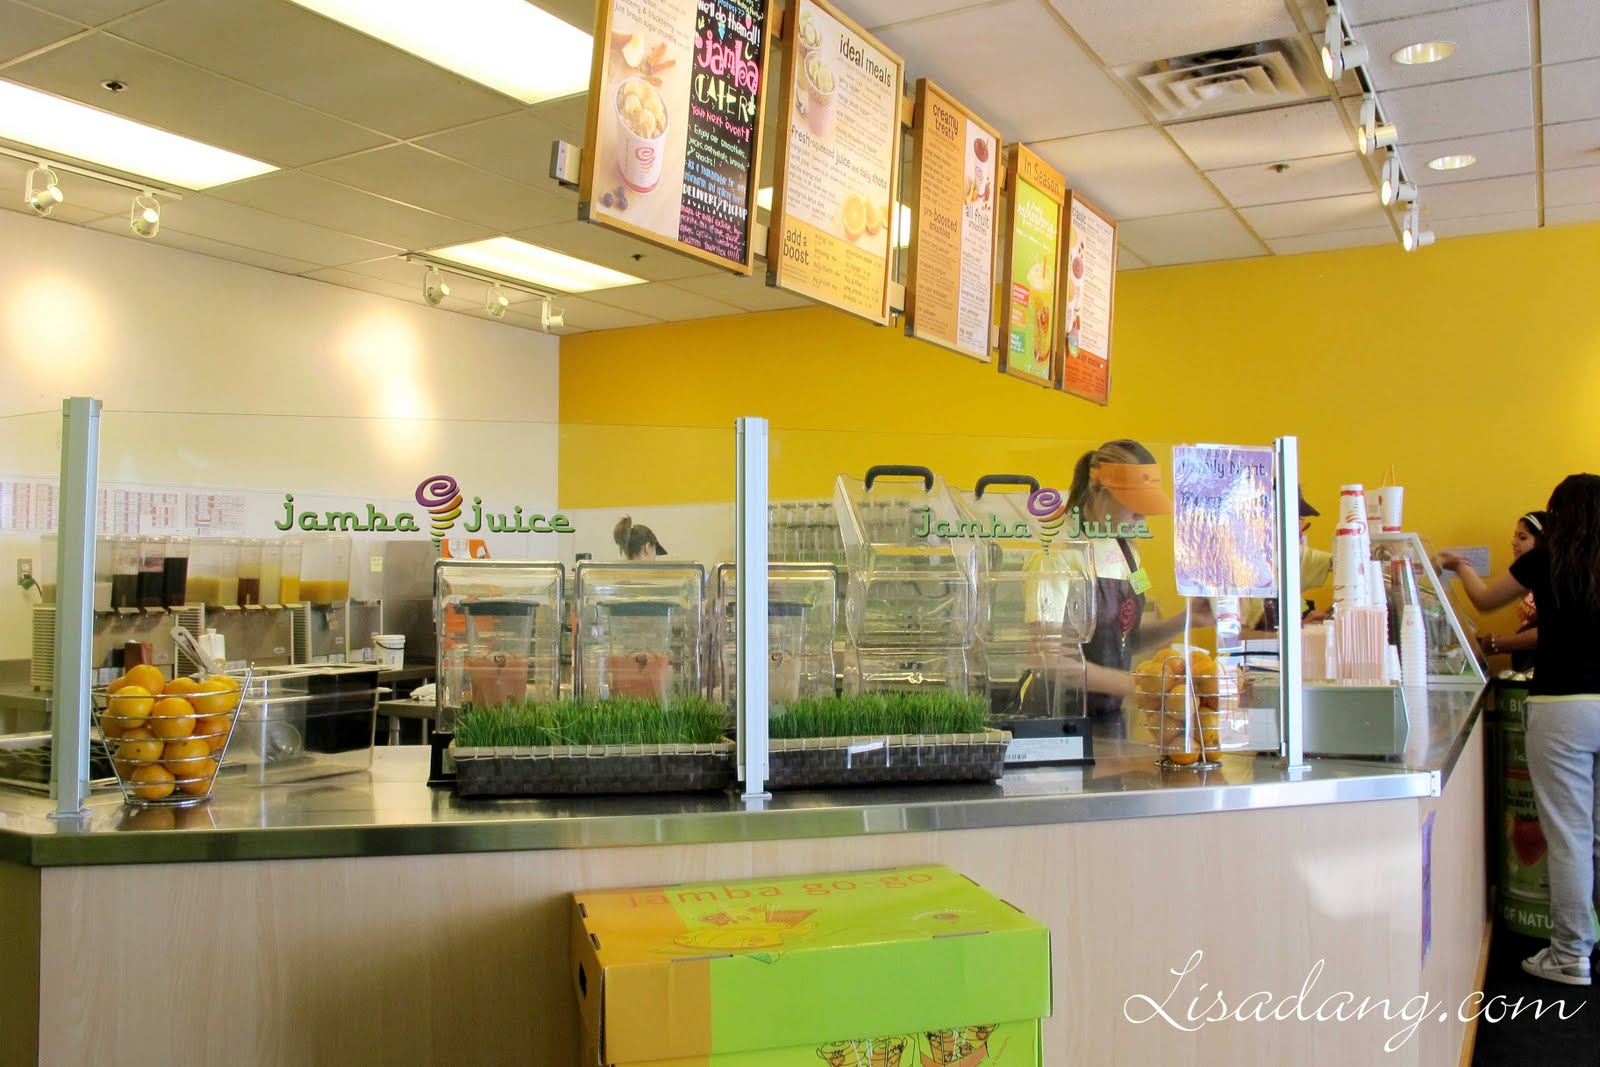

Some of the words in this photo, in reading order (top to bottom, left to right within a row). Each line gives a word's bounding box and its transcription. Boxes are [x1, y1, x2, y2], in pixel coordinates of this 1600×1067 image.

[715, 7, 727, 23] do
[728, 13, 747, 37] them
[698, 30, 759, 95] jamba
[840, 35, 864, 67] ideal
[866, 58, 891, 87] meals
[933, 104, 958, 135] creamy
[935, 119, 955, 140] treats
[790, 124, 834, 159] fresh-squeezed
[835, 151, 851, 168] juice
[1024, 155, 1032, 177] In
[1034, 162, 1059, 196] Season
[682, 183, 718, 207] DELIVERY
[783, 239, 809, 265] boost
[786, 229, 801, 246] add
[803, 235, 807, 246] a
[1229, 460, 1265, 480] Night
[274, 493, 420, 532] jamba
[463, 496, 576, 533] juice
[914, 503, 1032, 538] jamba
[1068, 505, 1153, 539] juice
[1503, 906, 1516, 920] OF
